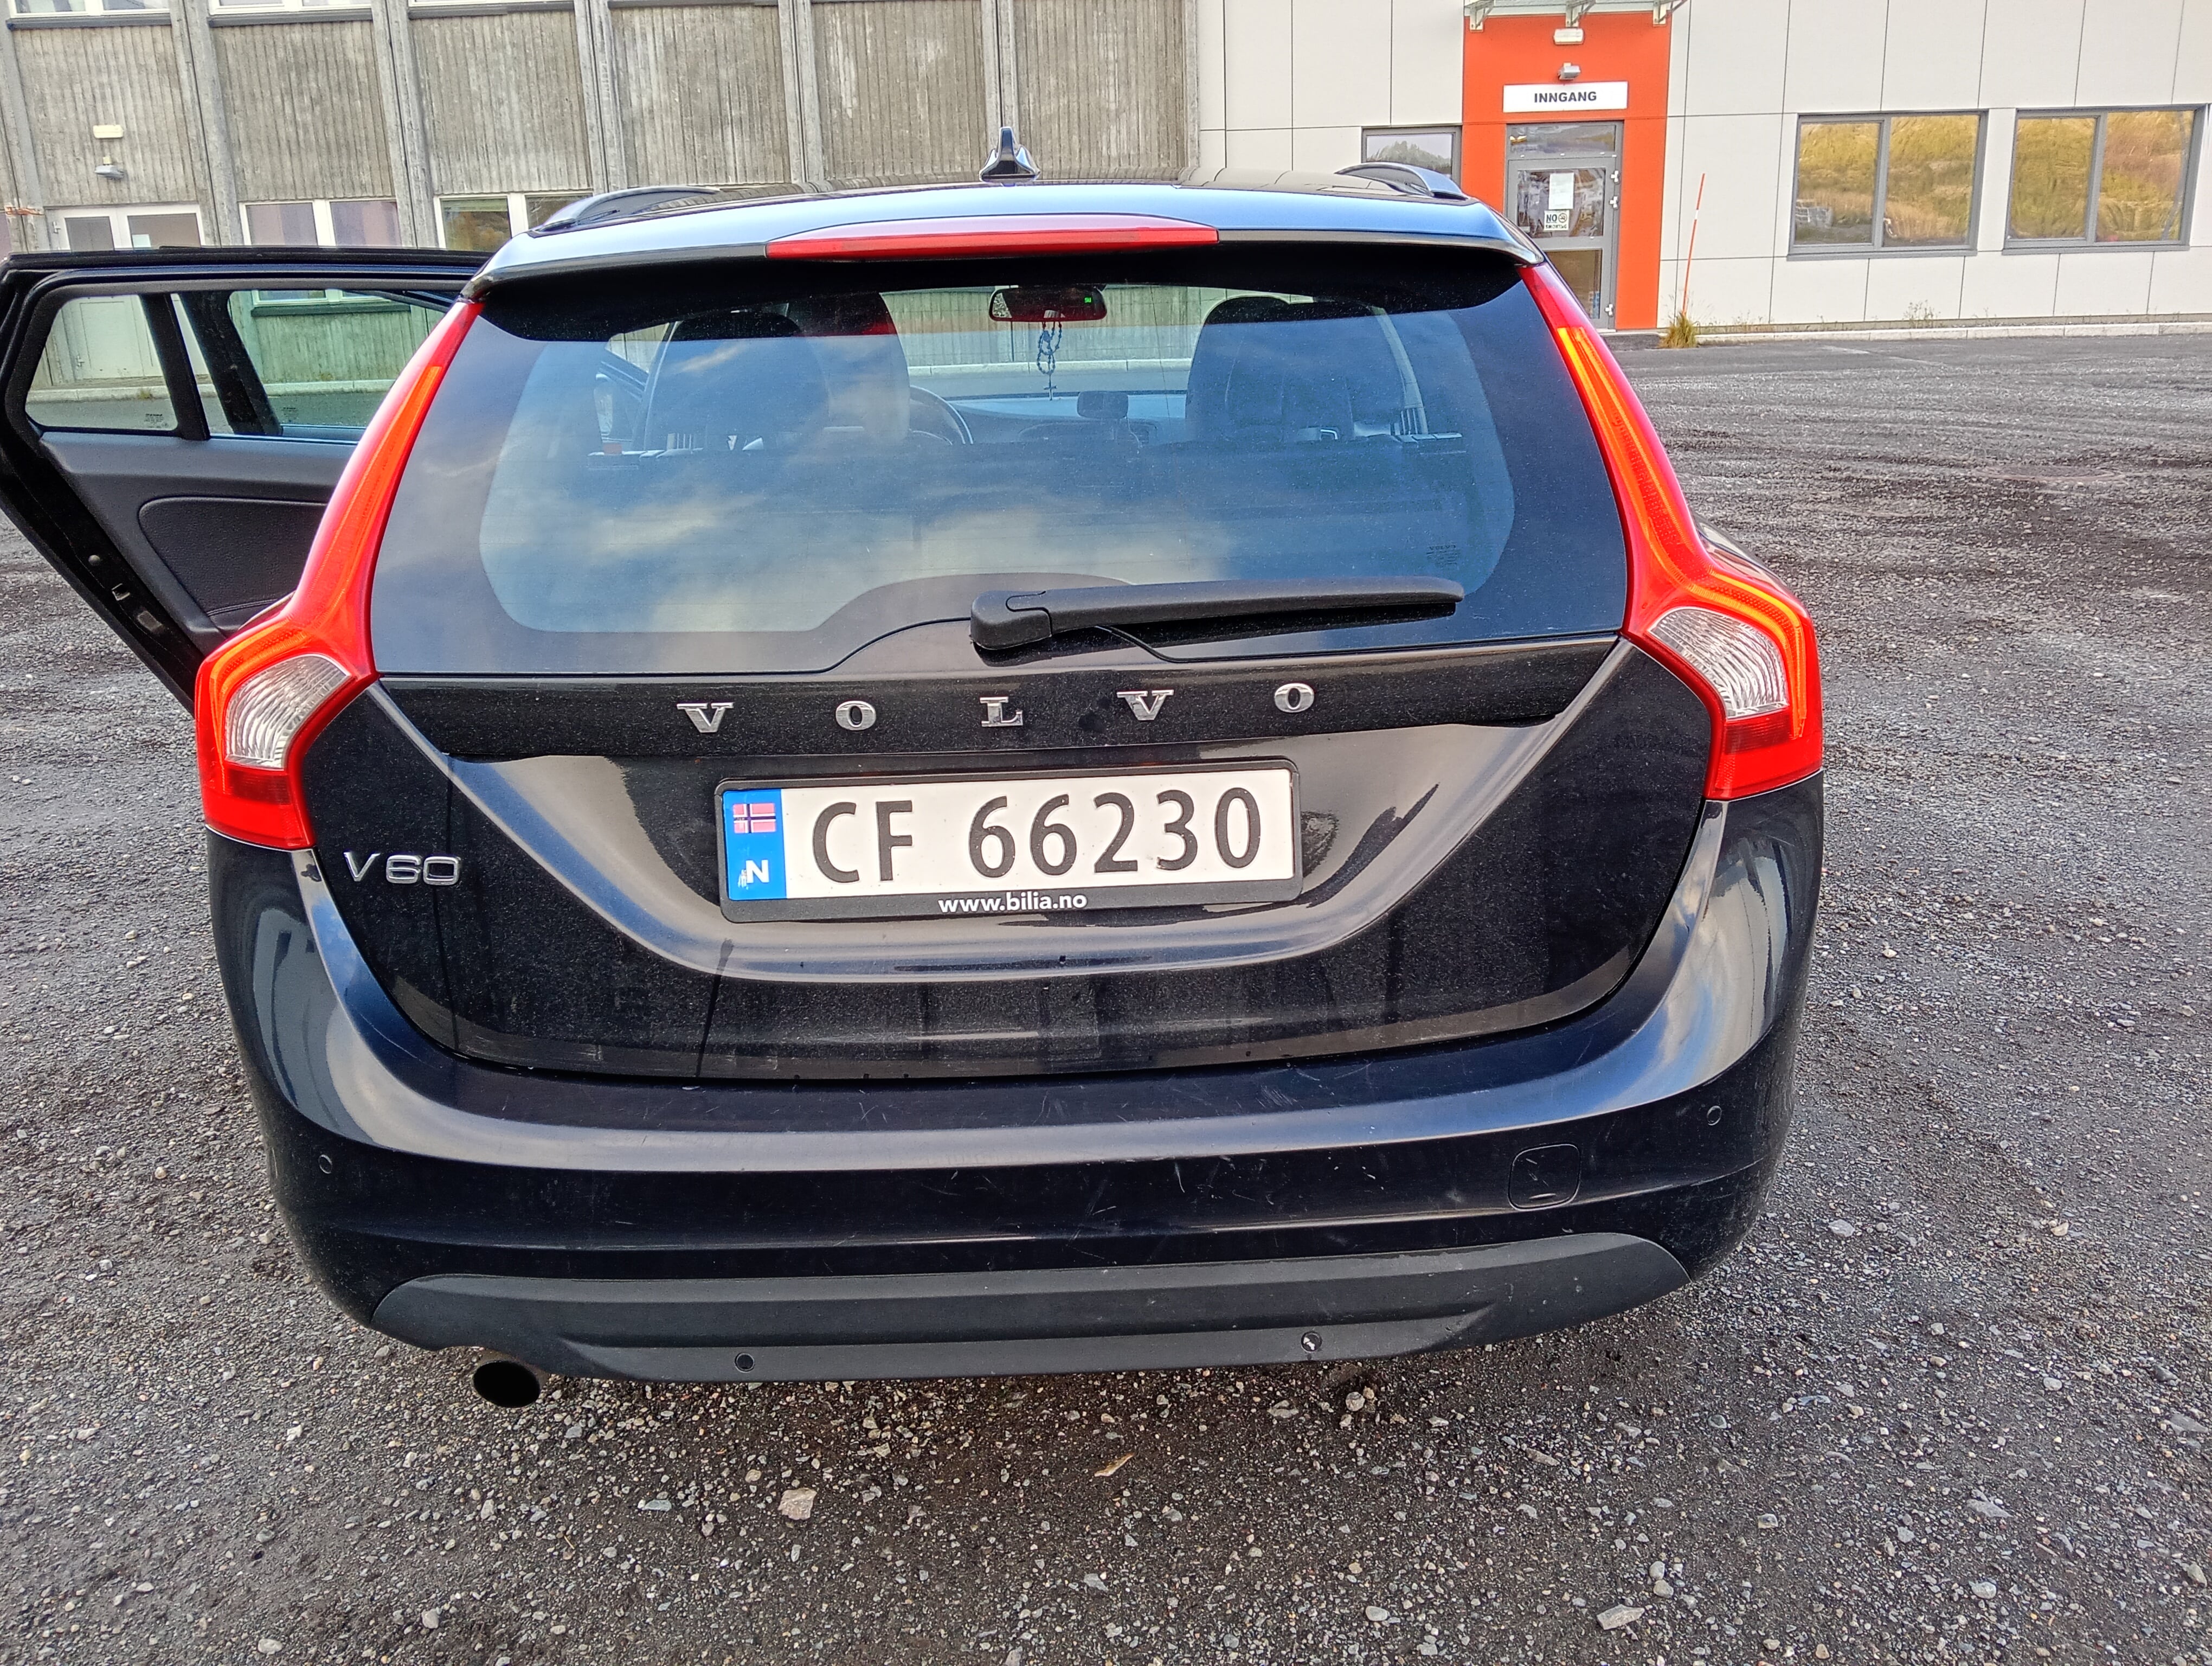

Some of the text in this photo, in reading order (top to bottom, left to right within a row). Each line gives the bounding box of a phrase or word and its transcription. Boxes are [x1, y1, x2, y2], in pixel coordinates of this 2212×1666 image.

[1534, 91, 1597, 103] INNGANG
[1546, 214, 1558, 222] NO
[677, 682, 1315, 733] VOLVO
[812, 787, 1261, 883] CF 66230
[745, 860, 770, 884] N
[937, 892, 1088, 913] www.bilia.no
